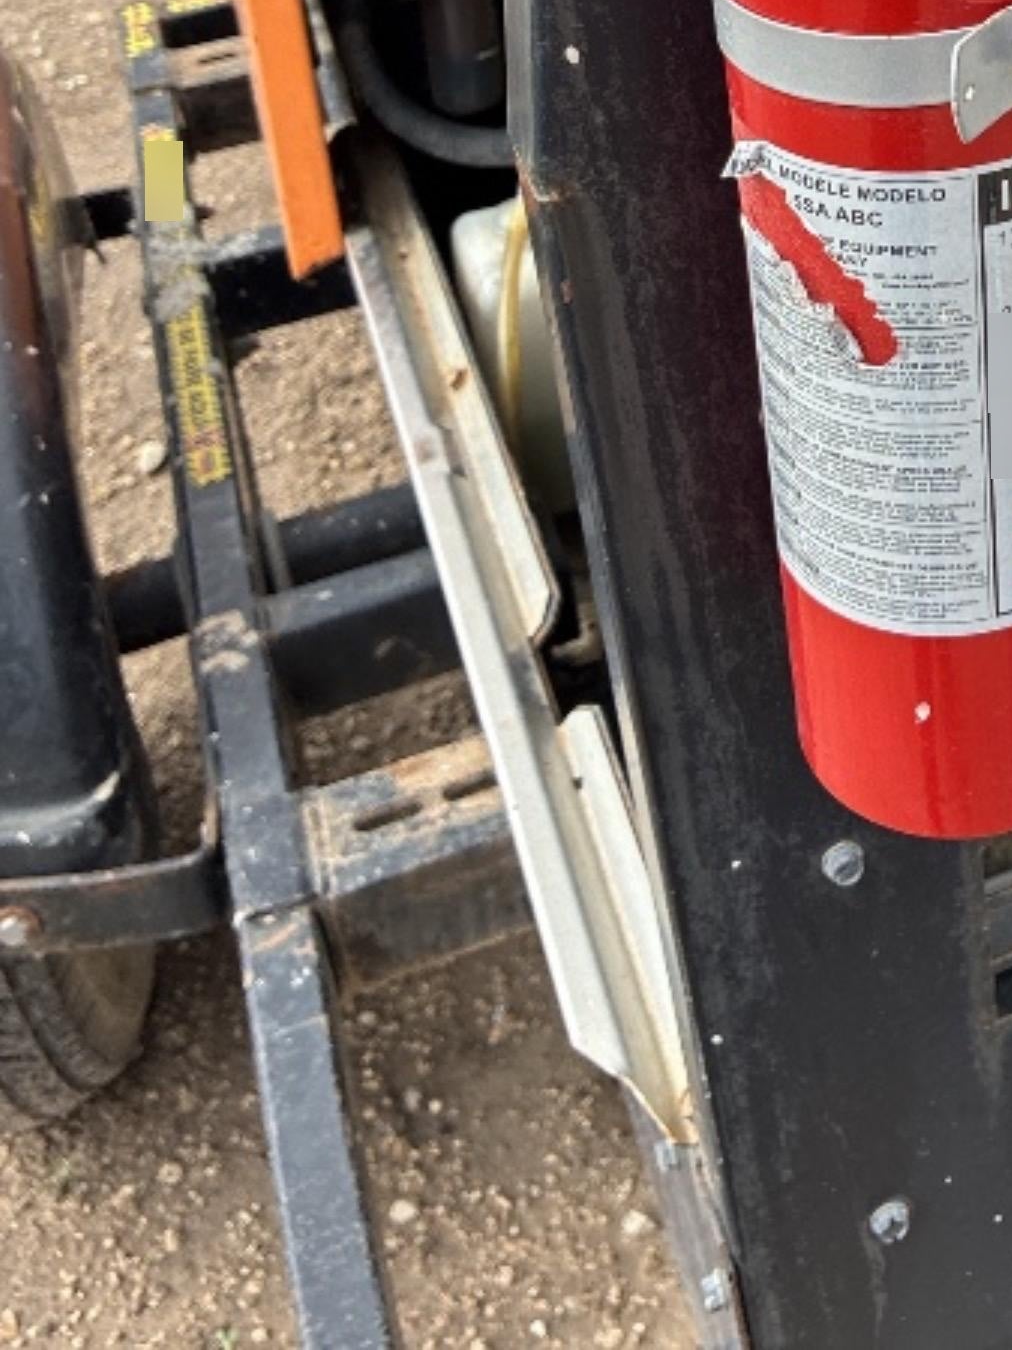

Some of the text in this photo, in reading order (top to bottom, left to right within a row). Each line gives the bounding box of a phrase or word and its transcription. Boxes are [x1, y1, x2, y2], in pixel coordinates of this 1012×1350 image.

[857, 187, 946, 204] MODELO
[836, 207, 884, 228] ABC
[838, 239, 939, 259] EQUIPMENT
